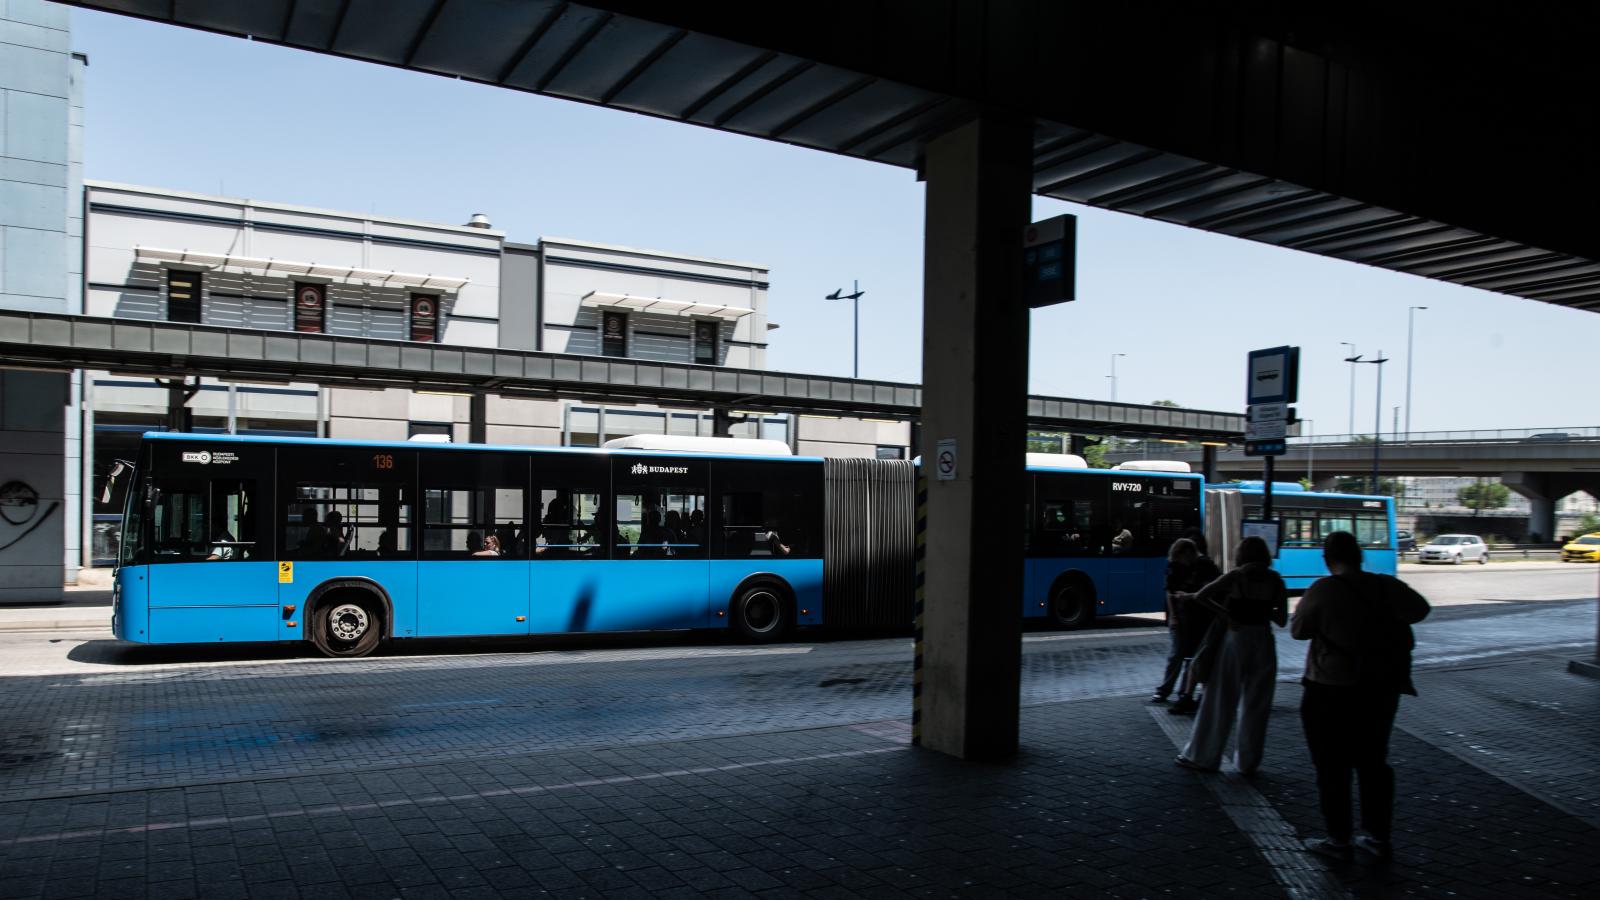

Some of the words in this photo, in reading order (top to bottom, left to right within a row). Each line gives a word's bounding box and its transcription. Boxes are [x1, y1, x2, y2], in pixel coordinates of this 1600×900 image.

[373, 454, 393, 469] 136
[649, 466, 689, 474] BUDAPEST
[1112, 482, 1142, 492] RVY-720
